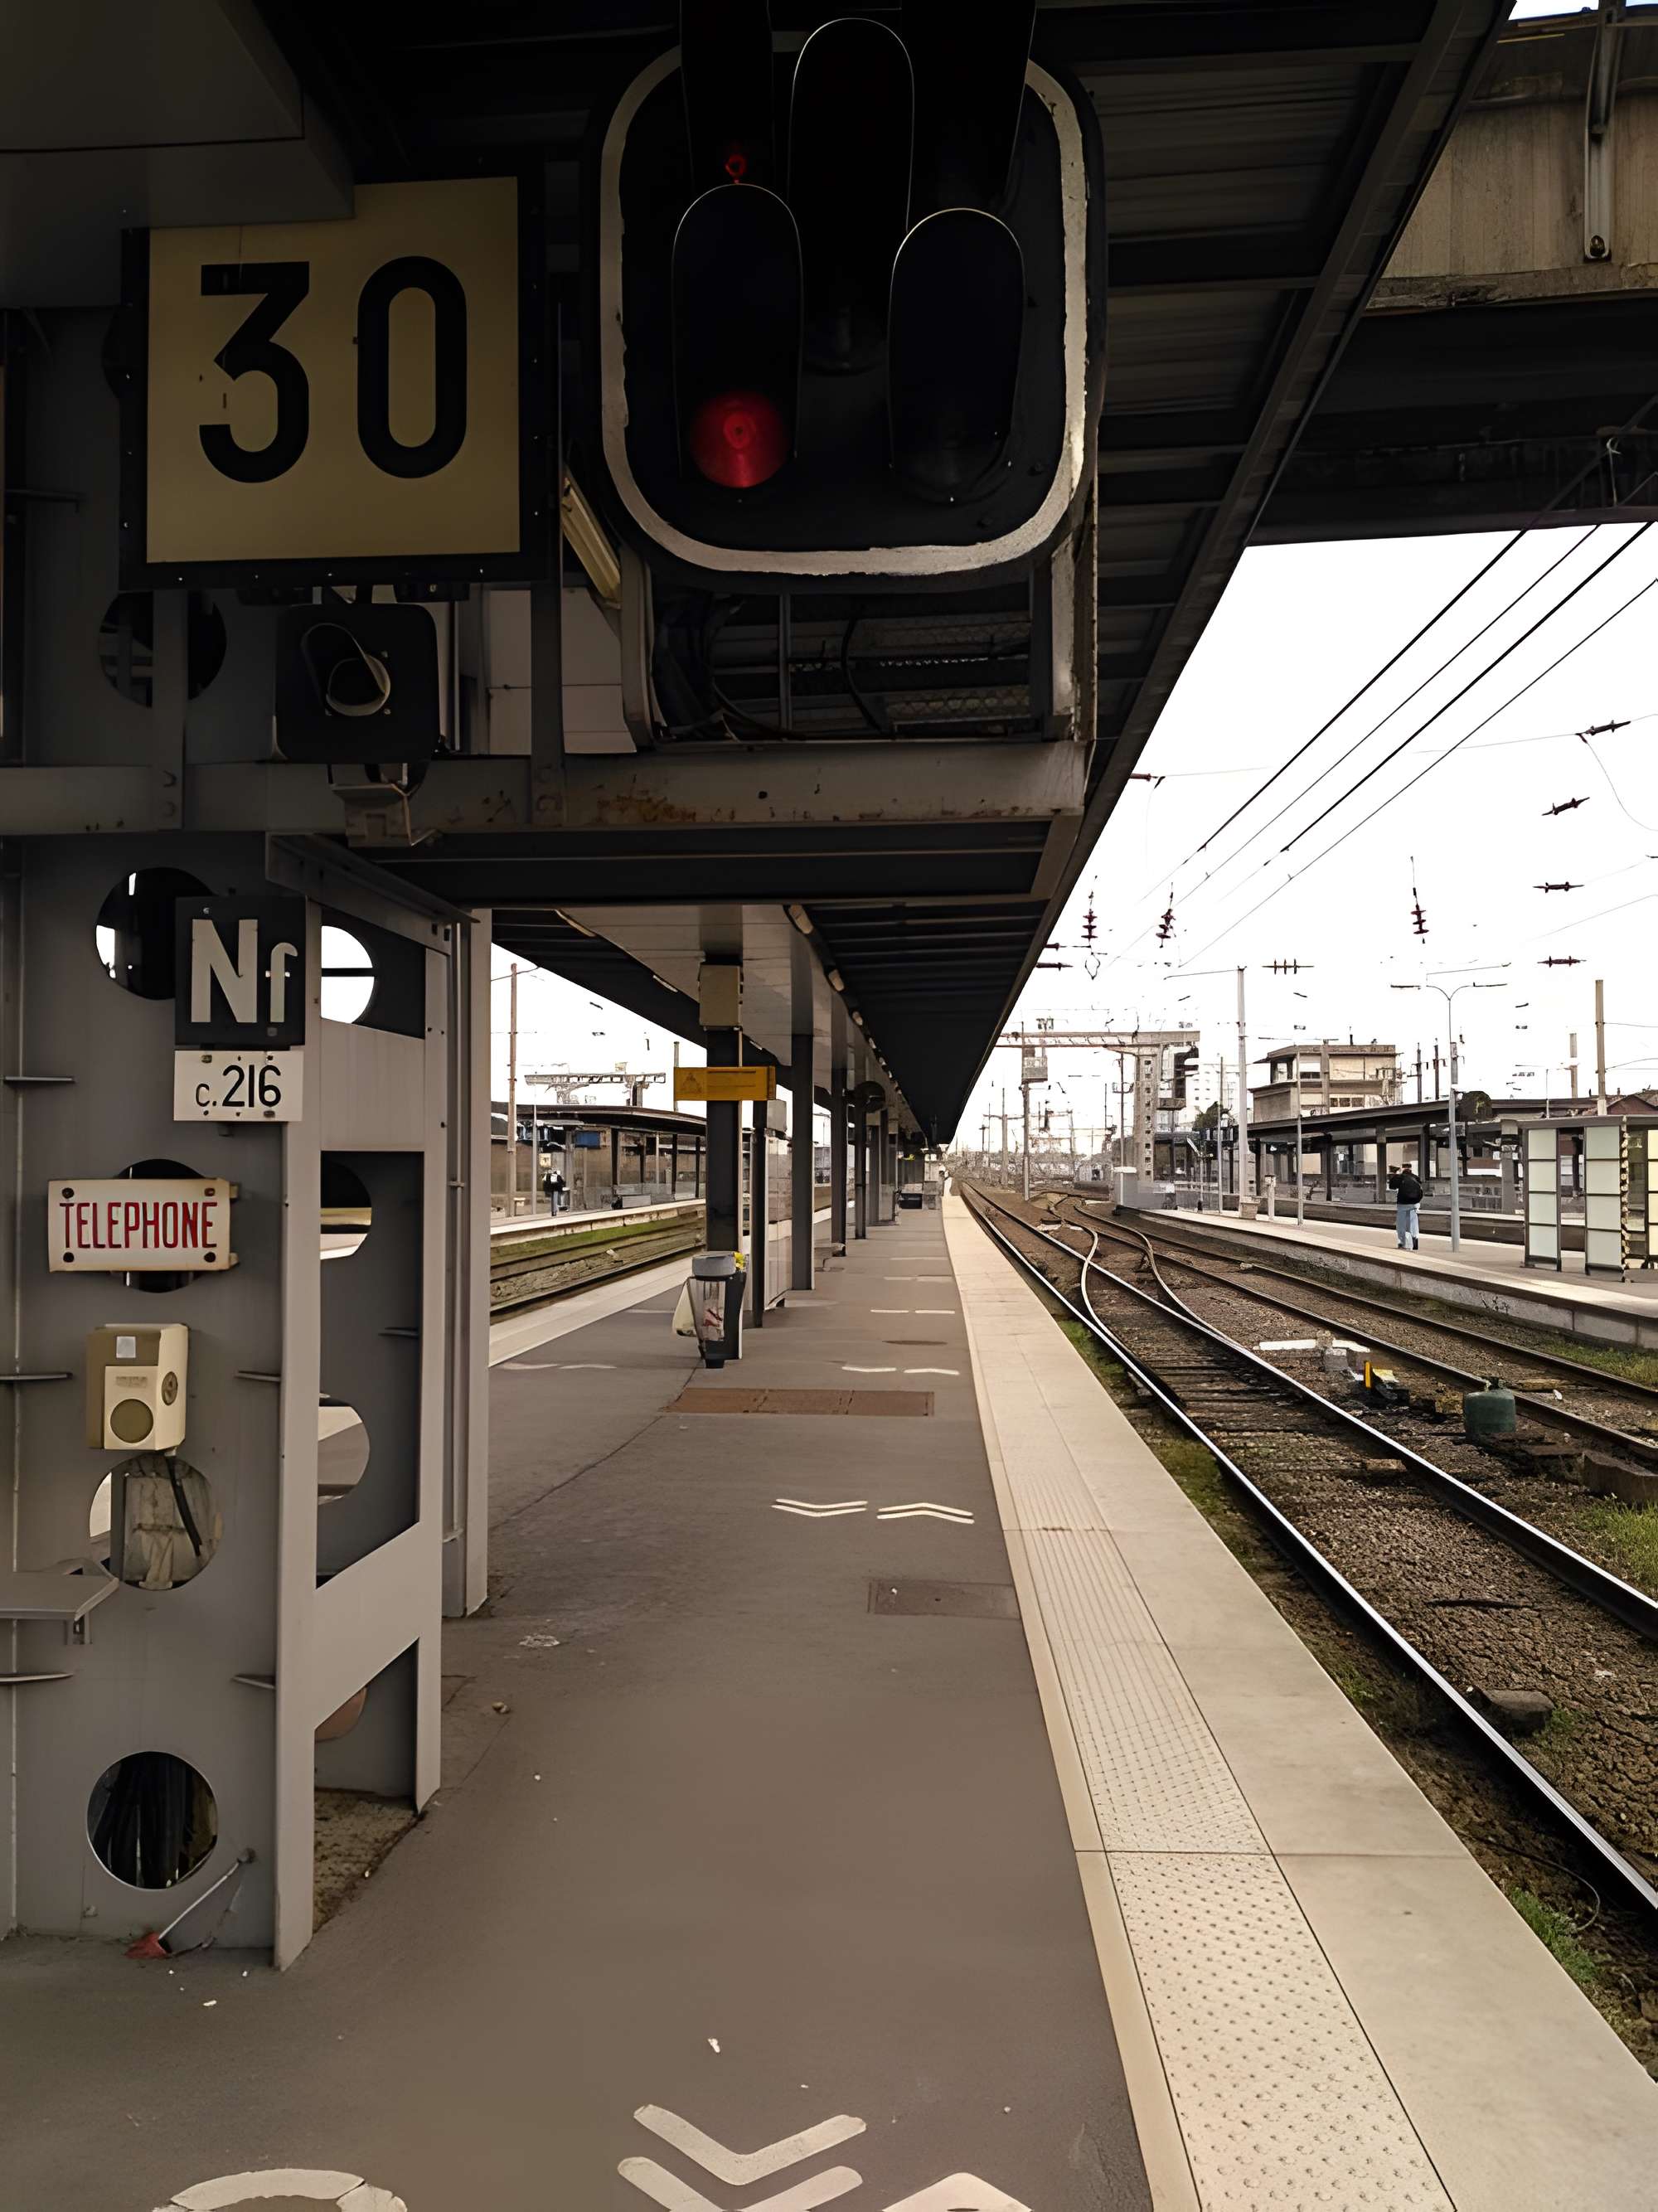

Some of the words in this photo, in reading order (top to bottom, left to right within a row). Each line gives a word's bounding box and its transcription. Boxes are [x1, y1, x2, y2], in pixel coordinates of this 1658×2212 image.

[199, 255, 468, 483] 30
[191, 919, 298, 1023] Nf
[59, 1201, 217, 1249] TELEPHONE
